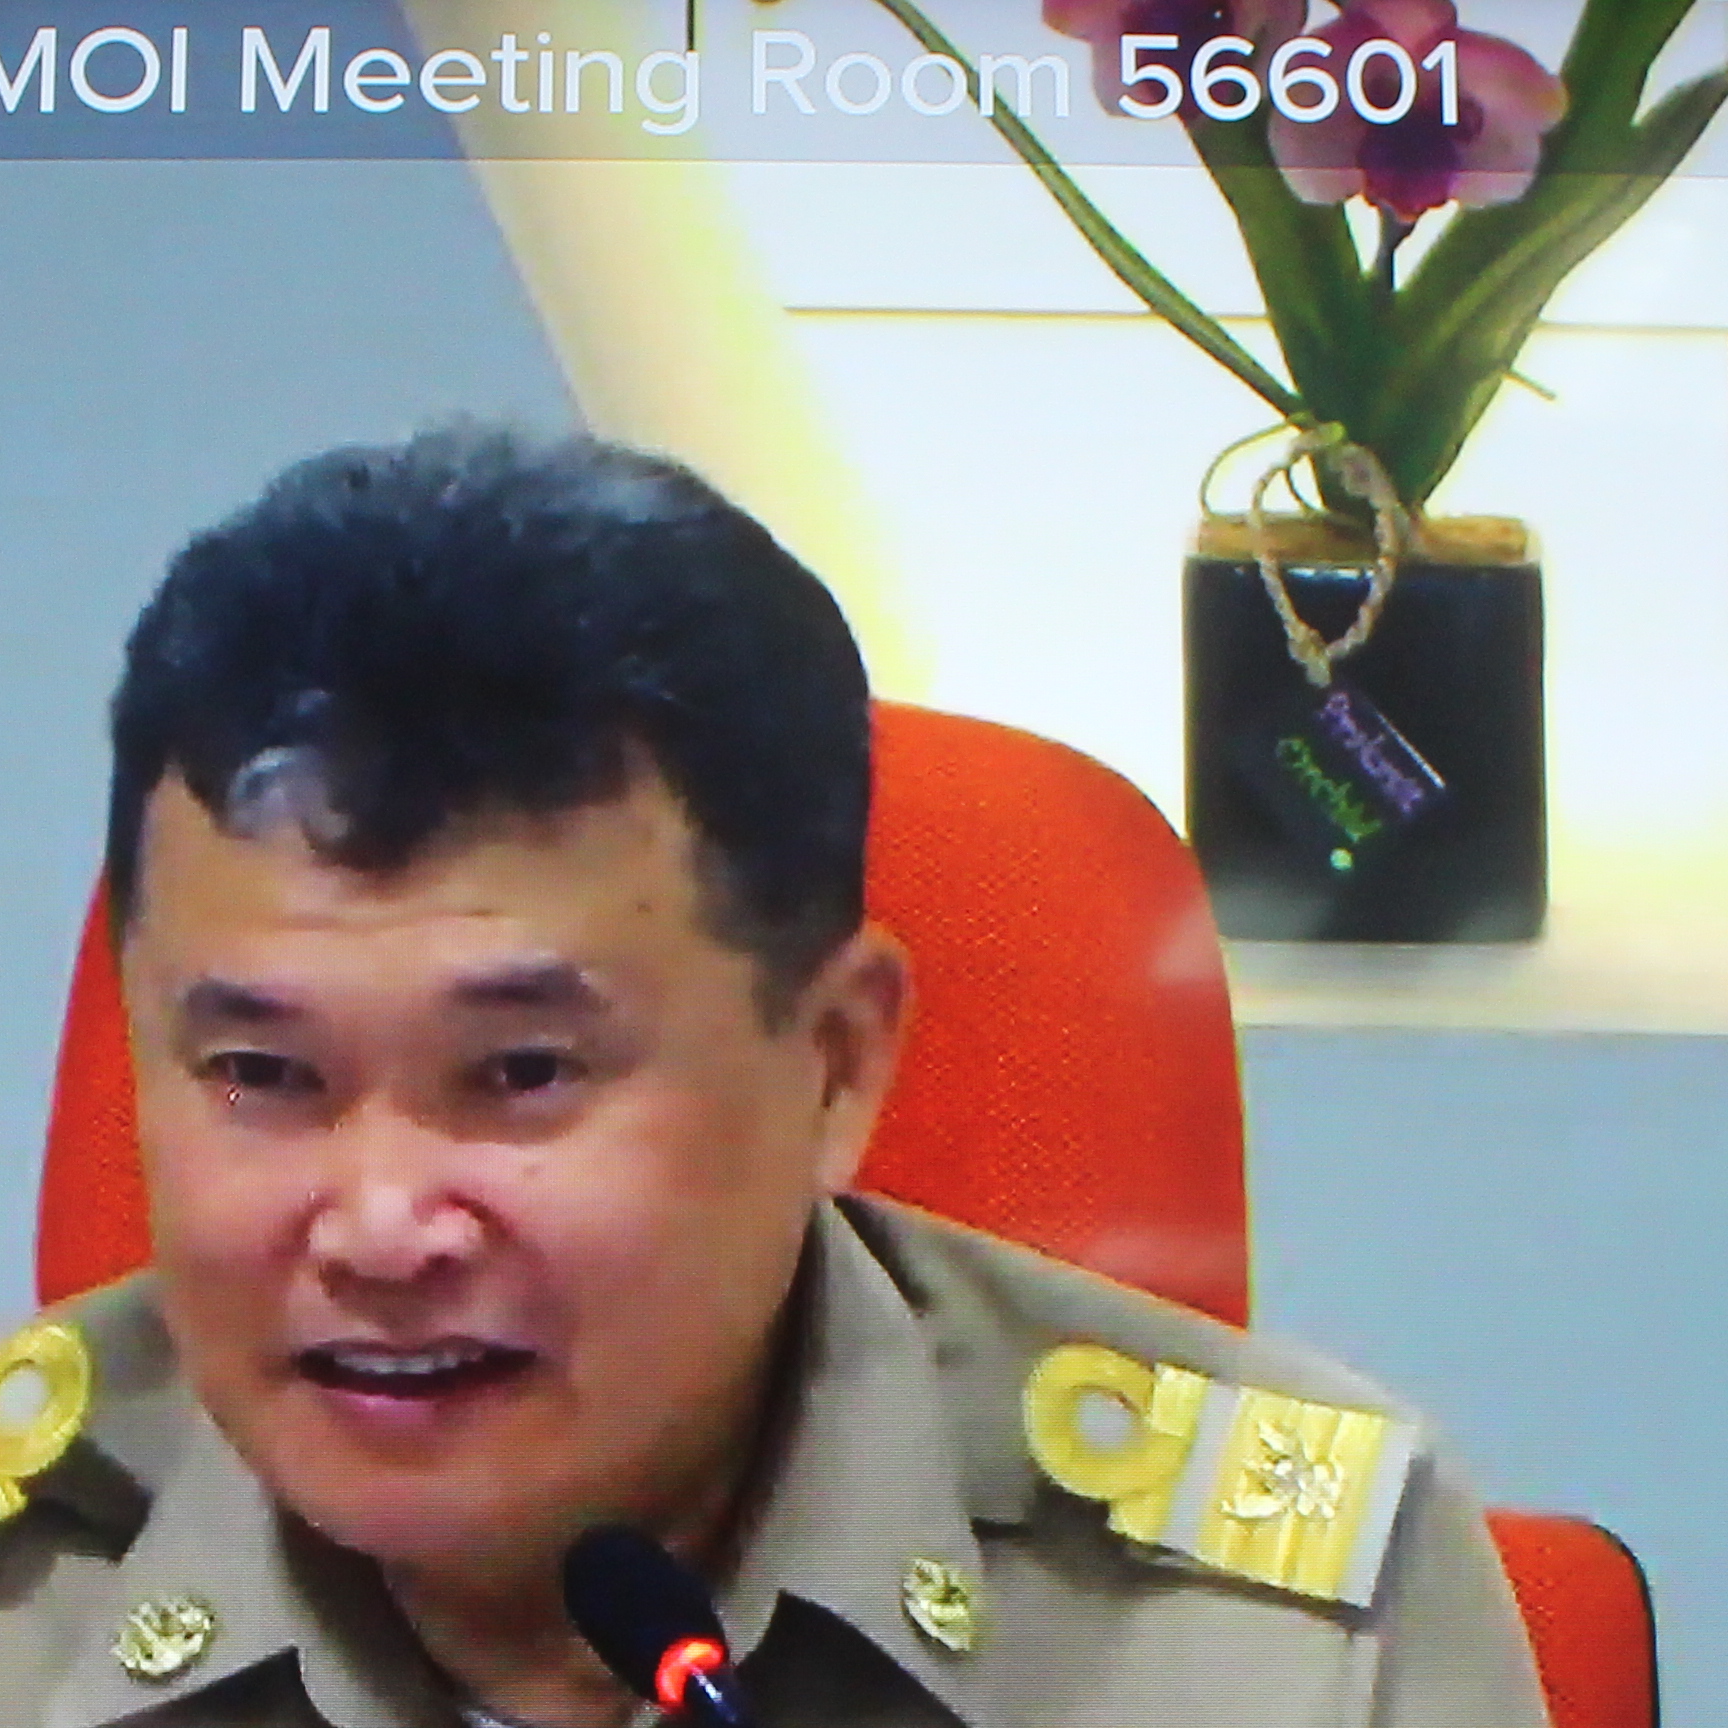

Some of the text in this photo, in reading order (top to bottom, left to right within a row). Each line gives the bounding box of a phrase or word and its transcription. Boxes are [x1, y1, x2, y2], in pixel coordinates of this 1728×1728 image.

[240, 26, 702, 136] Meeting
[750, 30, 1072, 118] Room
[1117, 34, 1460, 127] 56601
